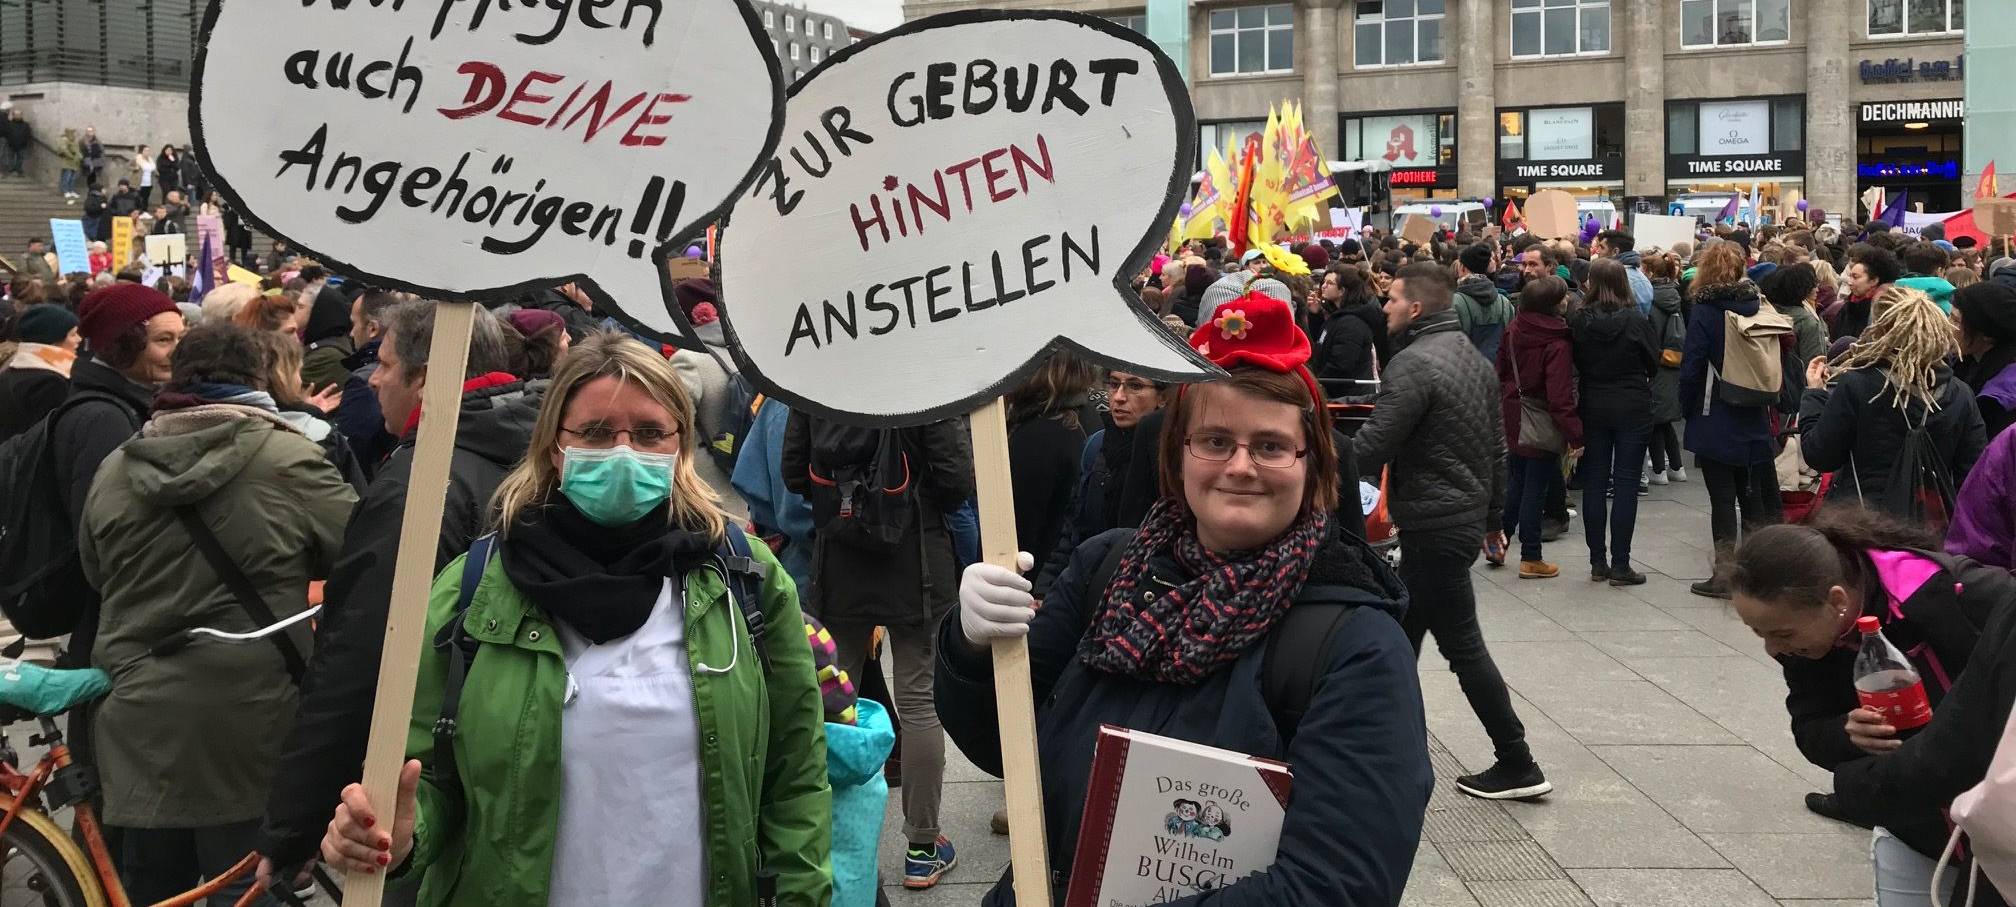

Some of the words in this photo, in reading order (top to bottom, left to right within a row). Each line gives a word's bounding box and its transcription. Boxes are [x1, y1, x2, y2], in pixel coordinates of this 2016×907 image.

[284, 36, 423, 113] auch
[437, 62, 692, 148] DEINE
[753, 106, 874, 216] ZUR
[887, 58, 1139, 127] GEBURT
[1391, 171, 1437, 183] APOTHEKE
[1517, 165, 1547, 177] TIME
[1551, 164, 1603, 176] SQUARE
[1688, 161, 1721, 173] TIME
[1725, 159, 1782, 172] SQUARE
[275, 123, 687, 259] Angehörigen!!
[784, 225, 1100, 356] ANSTELLEN
[1155, 776, 1192, 793] Das
[1198, 782, 1250, 812] große
[1154, 836, 1235, 870] Wilhelm
